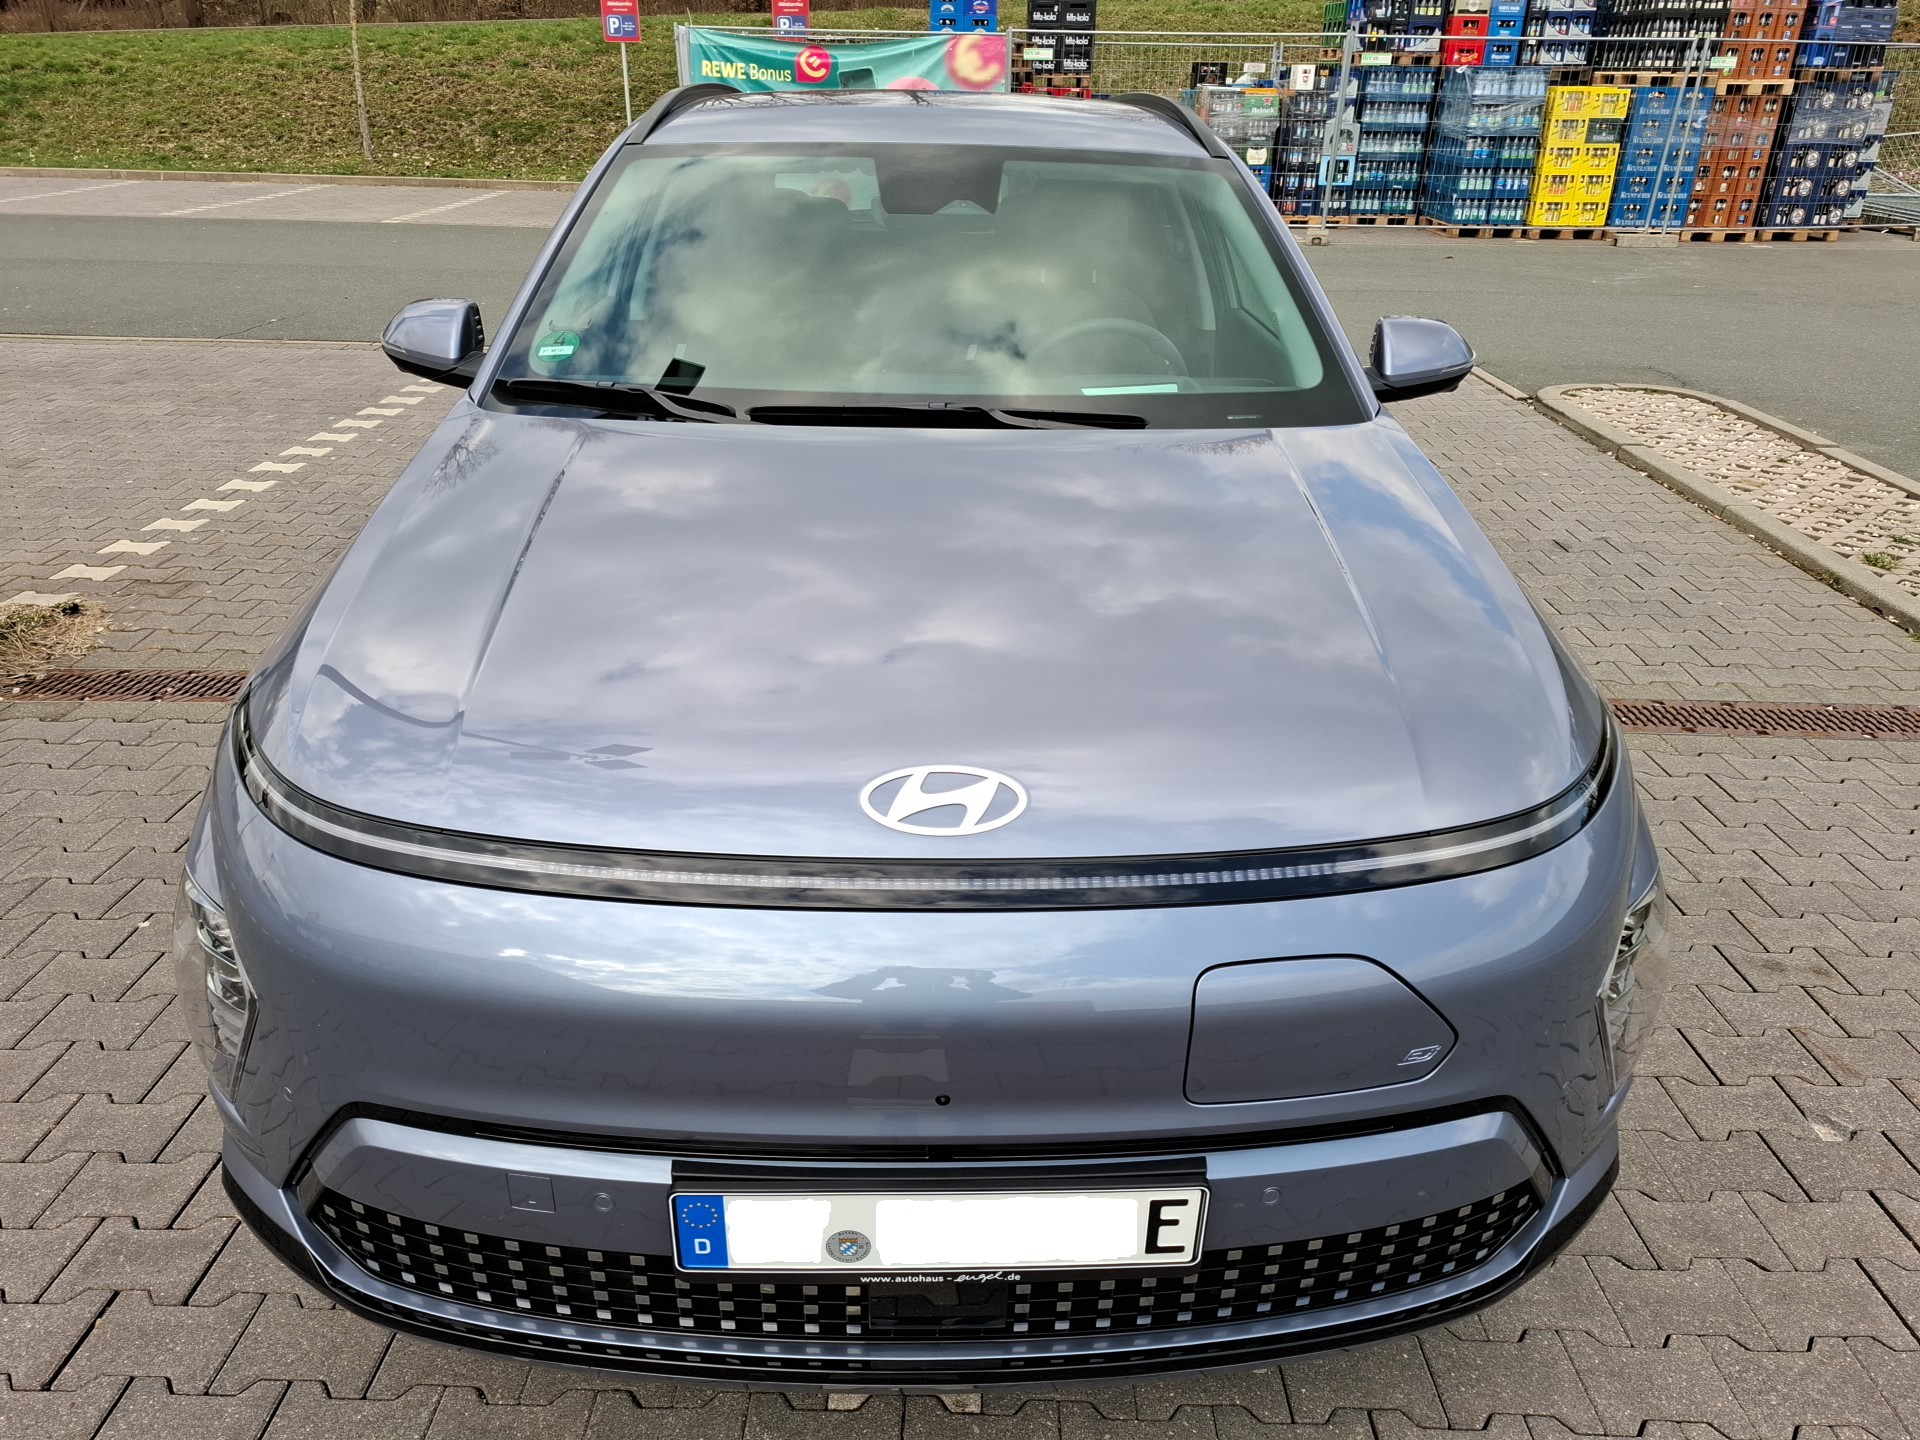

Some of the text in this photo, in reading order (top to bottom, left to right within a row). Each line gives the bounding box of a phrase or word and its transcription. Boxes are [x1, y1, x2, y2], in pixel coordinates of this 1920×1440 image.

[609, 17, 620, 34] P
[701, 60, 792, 82] REWE Bonus
[553, 331, 566, 346] 4
[1145, 1199, 1189, 1254] E
[694, 1238, 711, 1254] D
